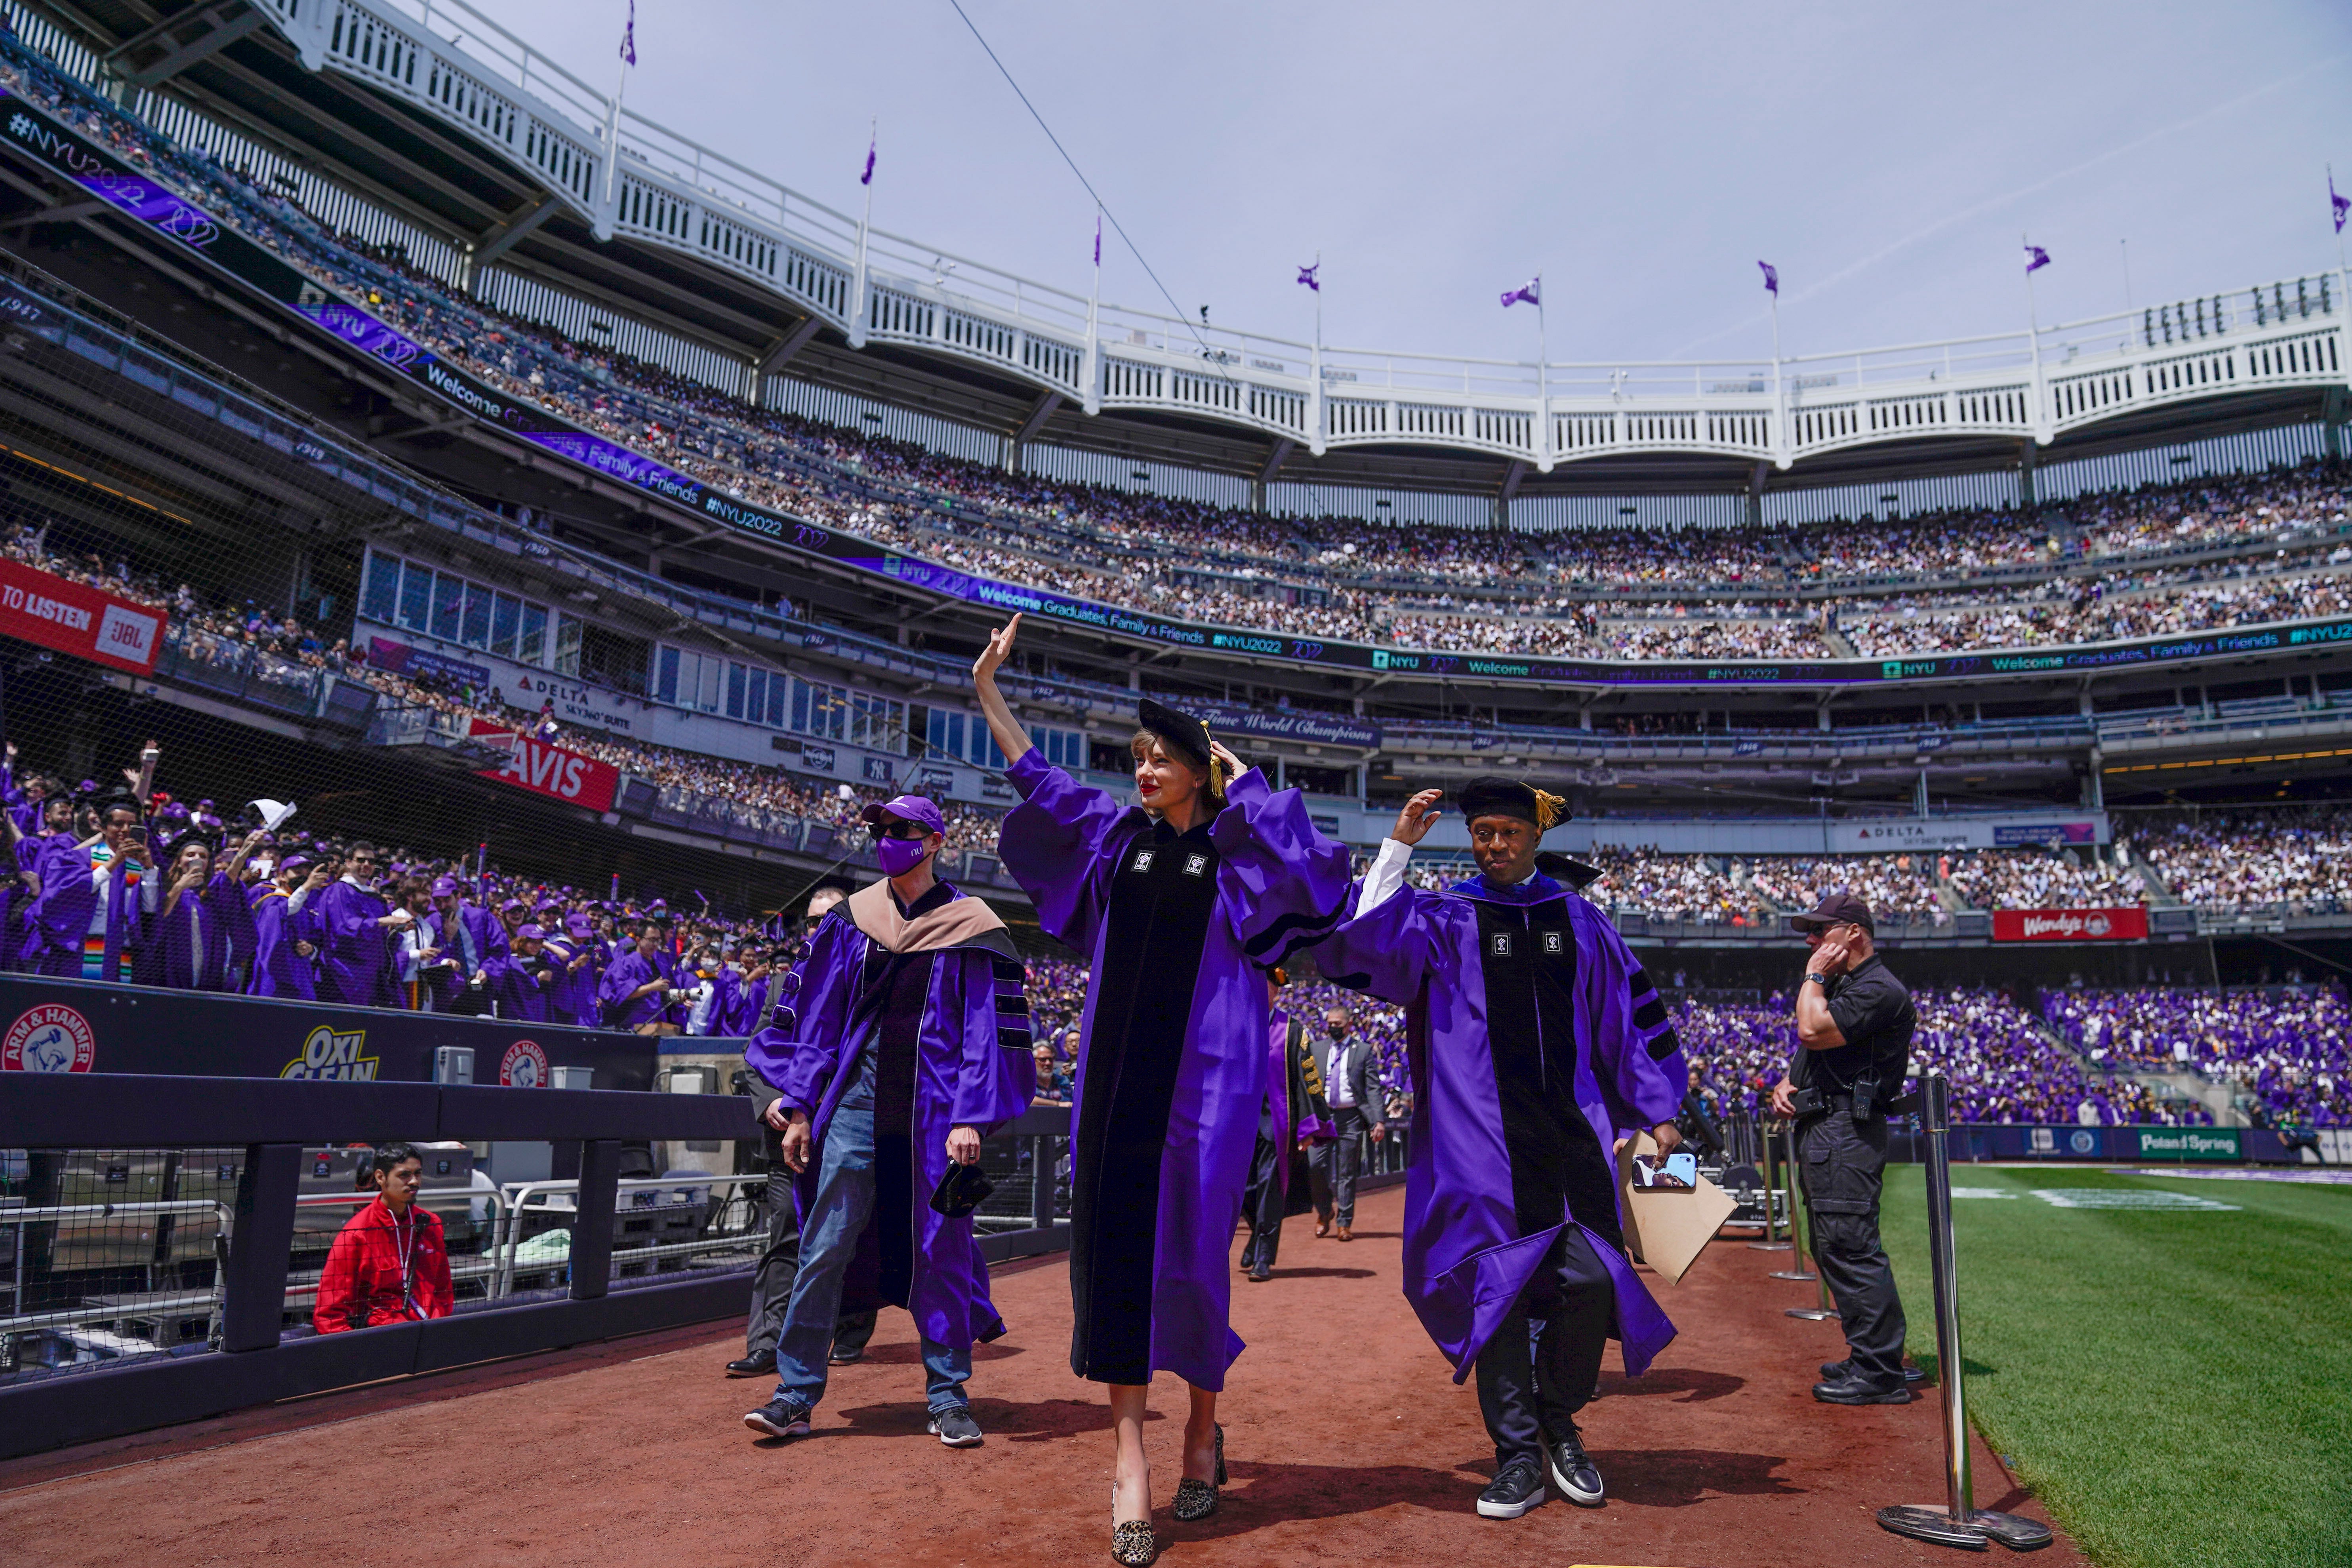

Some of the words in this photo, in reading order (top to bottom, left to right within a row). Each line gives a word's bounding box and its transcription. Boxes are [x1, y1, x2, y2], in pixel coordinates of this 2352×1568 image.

[8, 112, 146, 209] #NYU2022
[0, 297, 41, 320] 1947
[326, 305, 366, 337] NYU
[428, 362, 502, 417] Welcome
[588, 444, 635, 477] Family
[637, 469, 646, 480] &
[648, 470, 698, 504] Friends
[706, 496, 782, 537] #NYU2022
[902, 563, 930, 581] NYU
[2, 584, 25, 609] TO
[25, 593, 92, 632] LISTEN
[979, 585, 1041, 611] Welcome
[1043, 599, 1108, 627] Graduates,
[1110, 614, 1150, 635] Family
[1150, 625, 1157, 634] &
[1159, 625, 1205, 644] Friends
[111, 621, 142, 649] JBL
[1212, 633, 1282, 654] #NYU2022
[1389, 653, 1419, 669] NYU
[1992, 655, 2064, 670] Welcome
[2150, 642, 2202, 659] Family
[2217, 633, 2279, 651] Friends
[1468, 660, 1529, 676] Welcome
[1708, 668, 1779, 680] #NYU2022
[1904, 661, 1936, 674] NYU
[537, 680, 589, 705] DELTA
[1244, 714, 1294, 735] World
[1295, 718, 1373, 743] Champions
[500, 739, 585, 798] AVIS
[1874, 826, 1924, 837] DELTA
[2023, 912, 2083, 936] Wendy's
[6, 1025, 34, 1061] ARM
[30, 1012, 44, 1027] &
[46, 1008, 90, 1065] HAMMER
[305, 1029, 361, 1069] OXI
[502, 1056, 515, 1080] ARM
[514, 1048, 521, 1056] &
[522, 1042, 547, 1084] HAMMER
[2141, 1134, 2187, 1151] Poland
[2188, 1134, 2236, 1154] Spring
